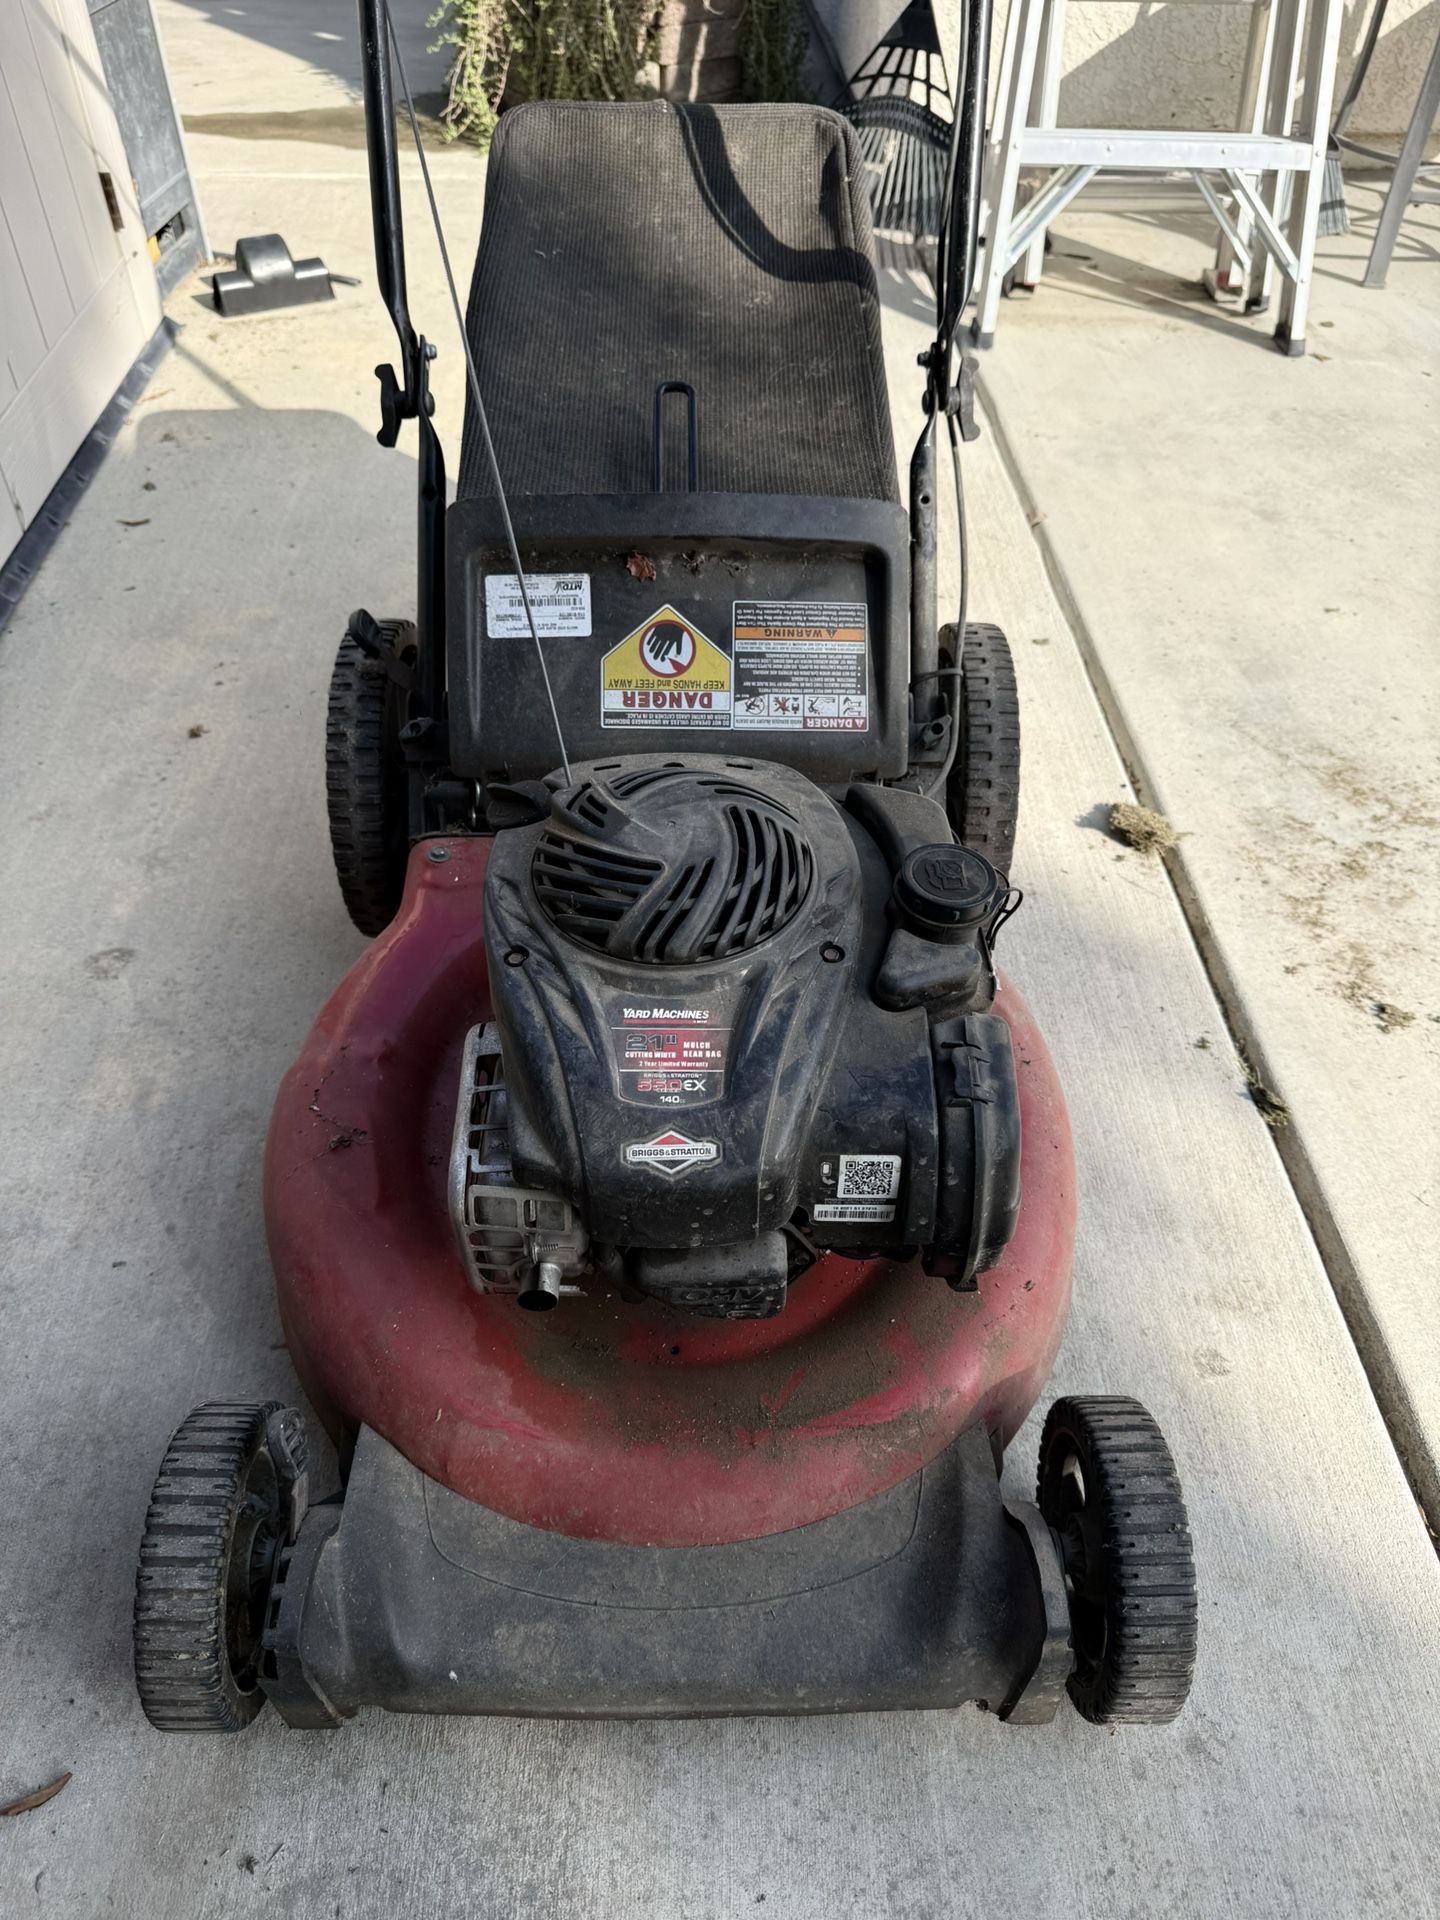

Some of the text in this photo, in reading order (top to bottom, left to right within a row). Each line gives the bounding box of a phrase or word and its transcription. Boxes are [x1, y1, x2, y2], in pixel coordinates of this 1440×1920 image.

[562, 583, 583, 591] MTD
[764, 628, 823, 638] WARNING
[608, 679, 725, 690] KEEP HANDS and FEET AWAY
[622, 691, 713, 709] DANGER
[806, 718, 853, 728] DANGER
[623, 1008, 710, 1019] YARD MACHINES
[683, 1041, 711, 1049] MULCH
[625, 1051, 677, 1059] CUTTING WIDTH
[683, 1050, 703, 1058] REAR
[681, 1061, 709, 1069] Warranty
